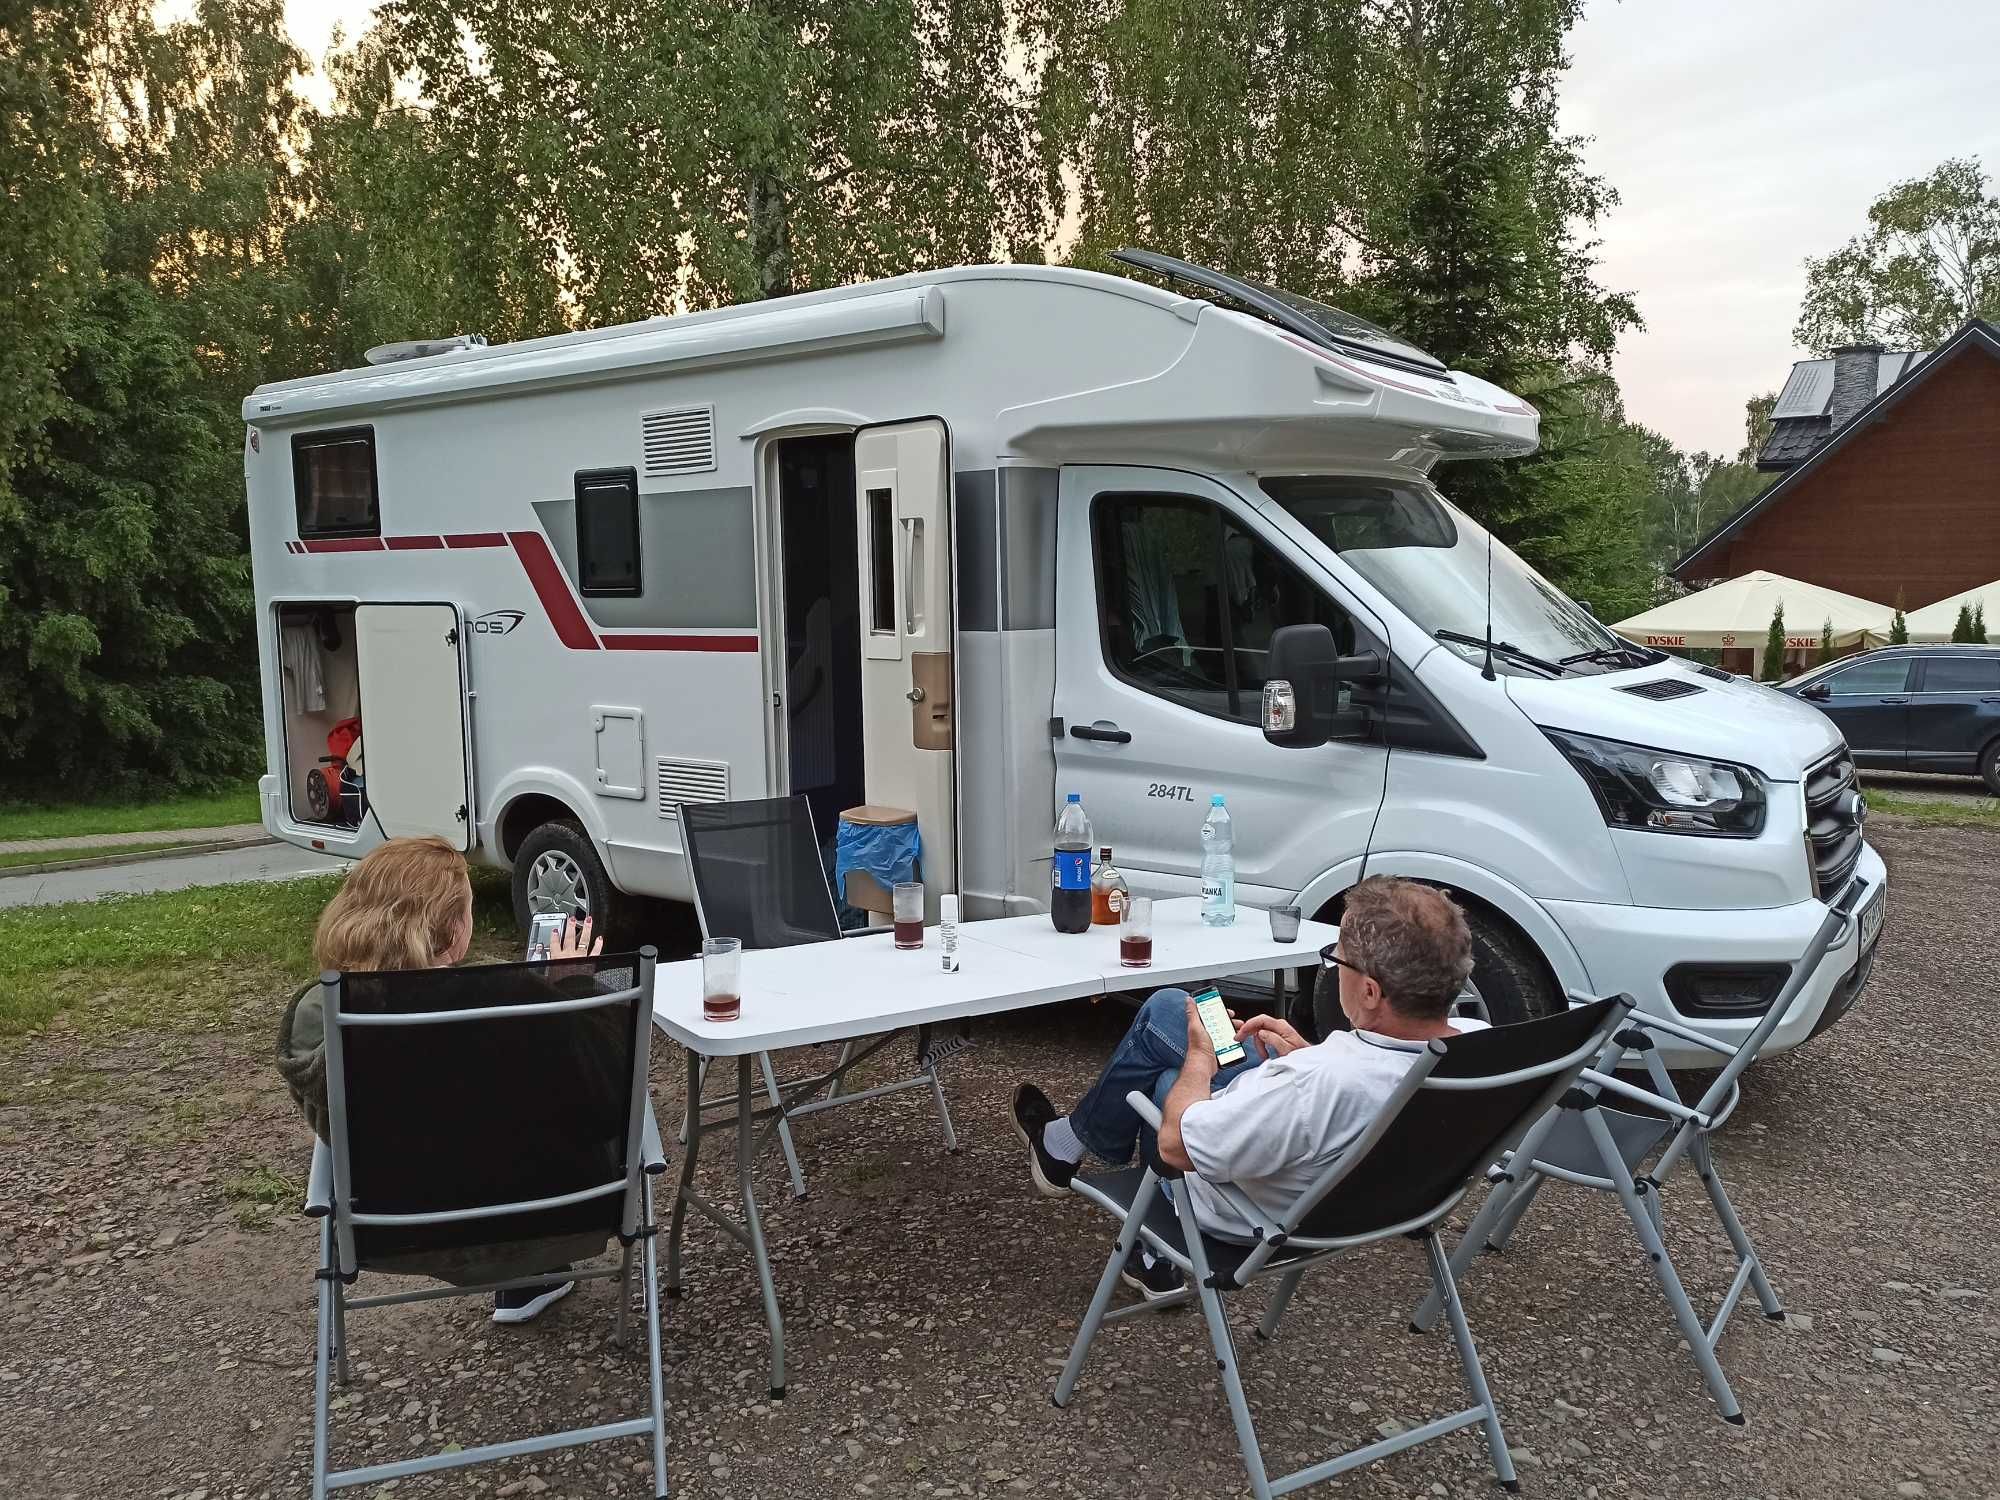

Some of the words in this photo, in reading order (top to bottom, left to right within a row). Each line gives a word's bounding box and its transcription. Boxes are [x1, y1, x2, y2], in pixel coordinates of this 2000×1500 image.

[1646, 635, 1686, 646] TYSKIE
[1784, 637, 1817, 647] YSKIE
[1147, 783, 1195, 802] 284TL
